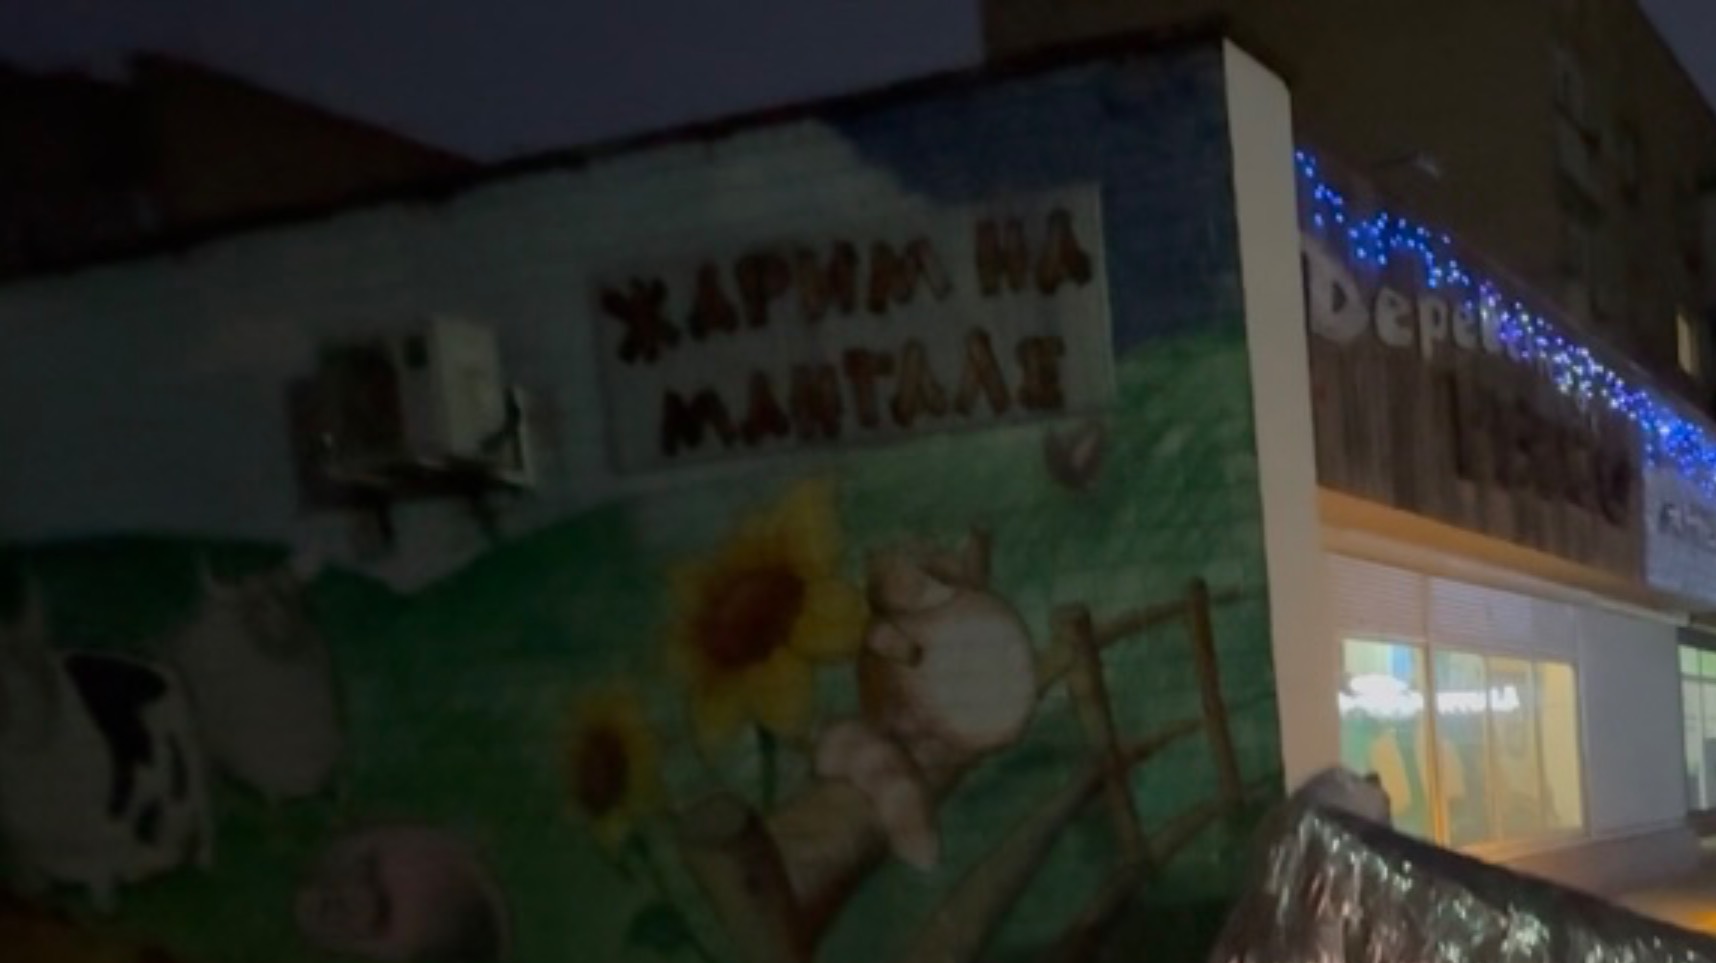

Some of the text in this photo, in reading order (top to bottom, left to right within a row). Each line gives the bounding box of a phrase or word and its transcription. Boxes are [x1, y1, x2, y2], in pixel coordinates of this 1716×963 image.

[602, 207, 1094, 366] ЖАРИМ НА
[661, 326, 1066, 458] МАНГАЛЕ
